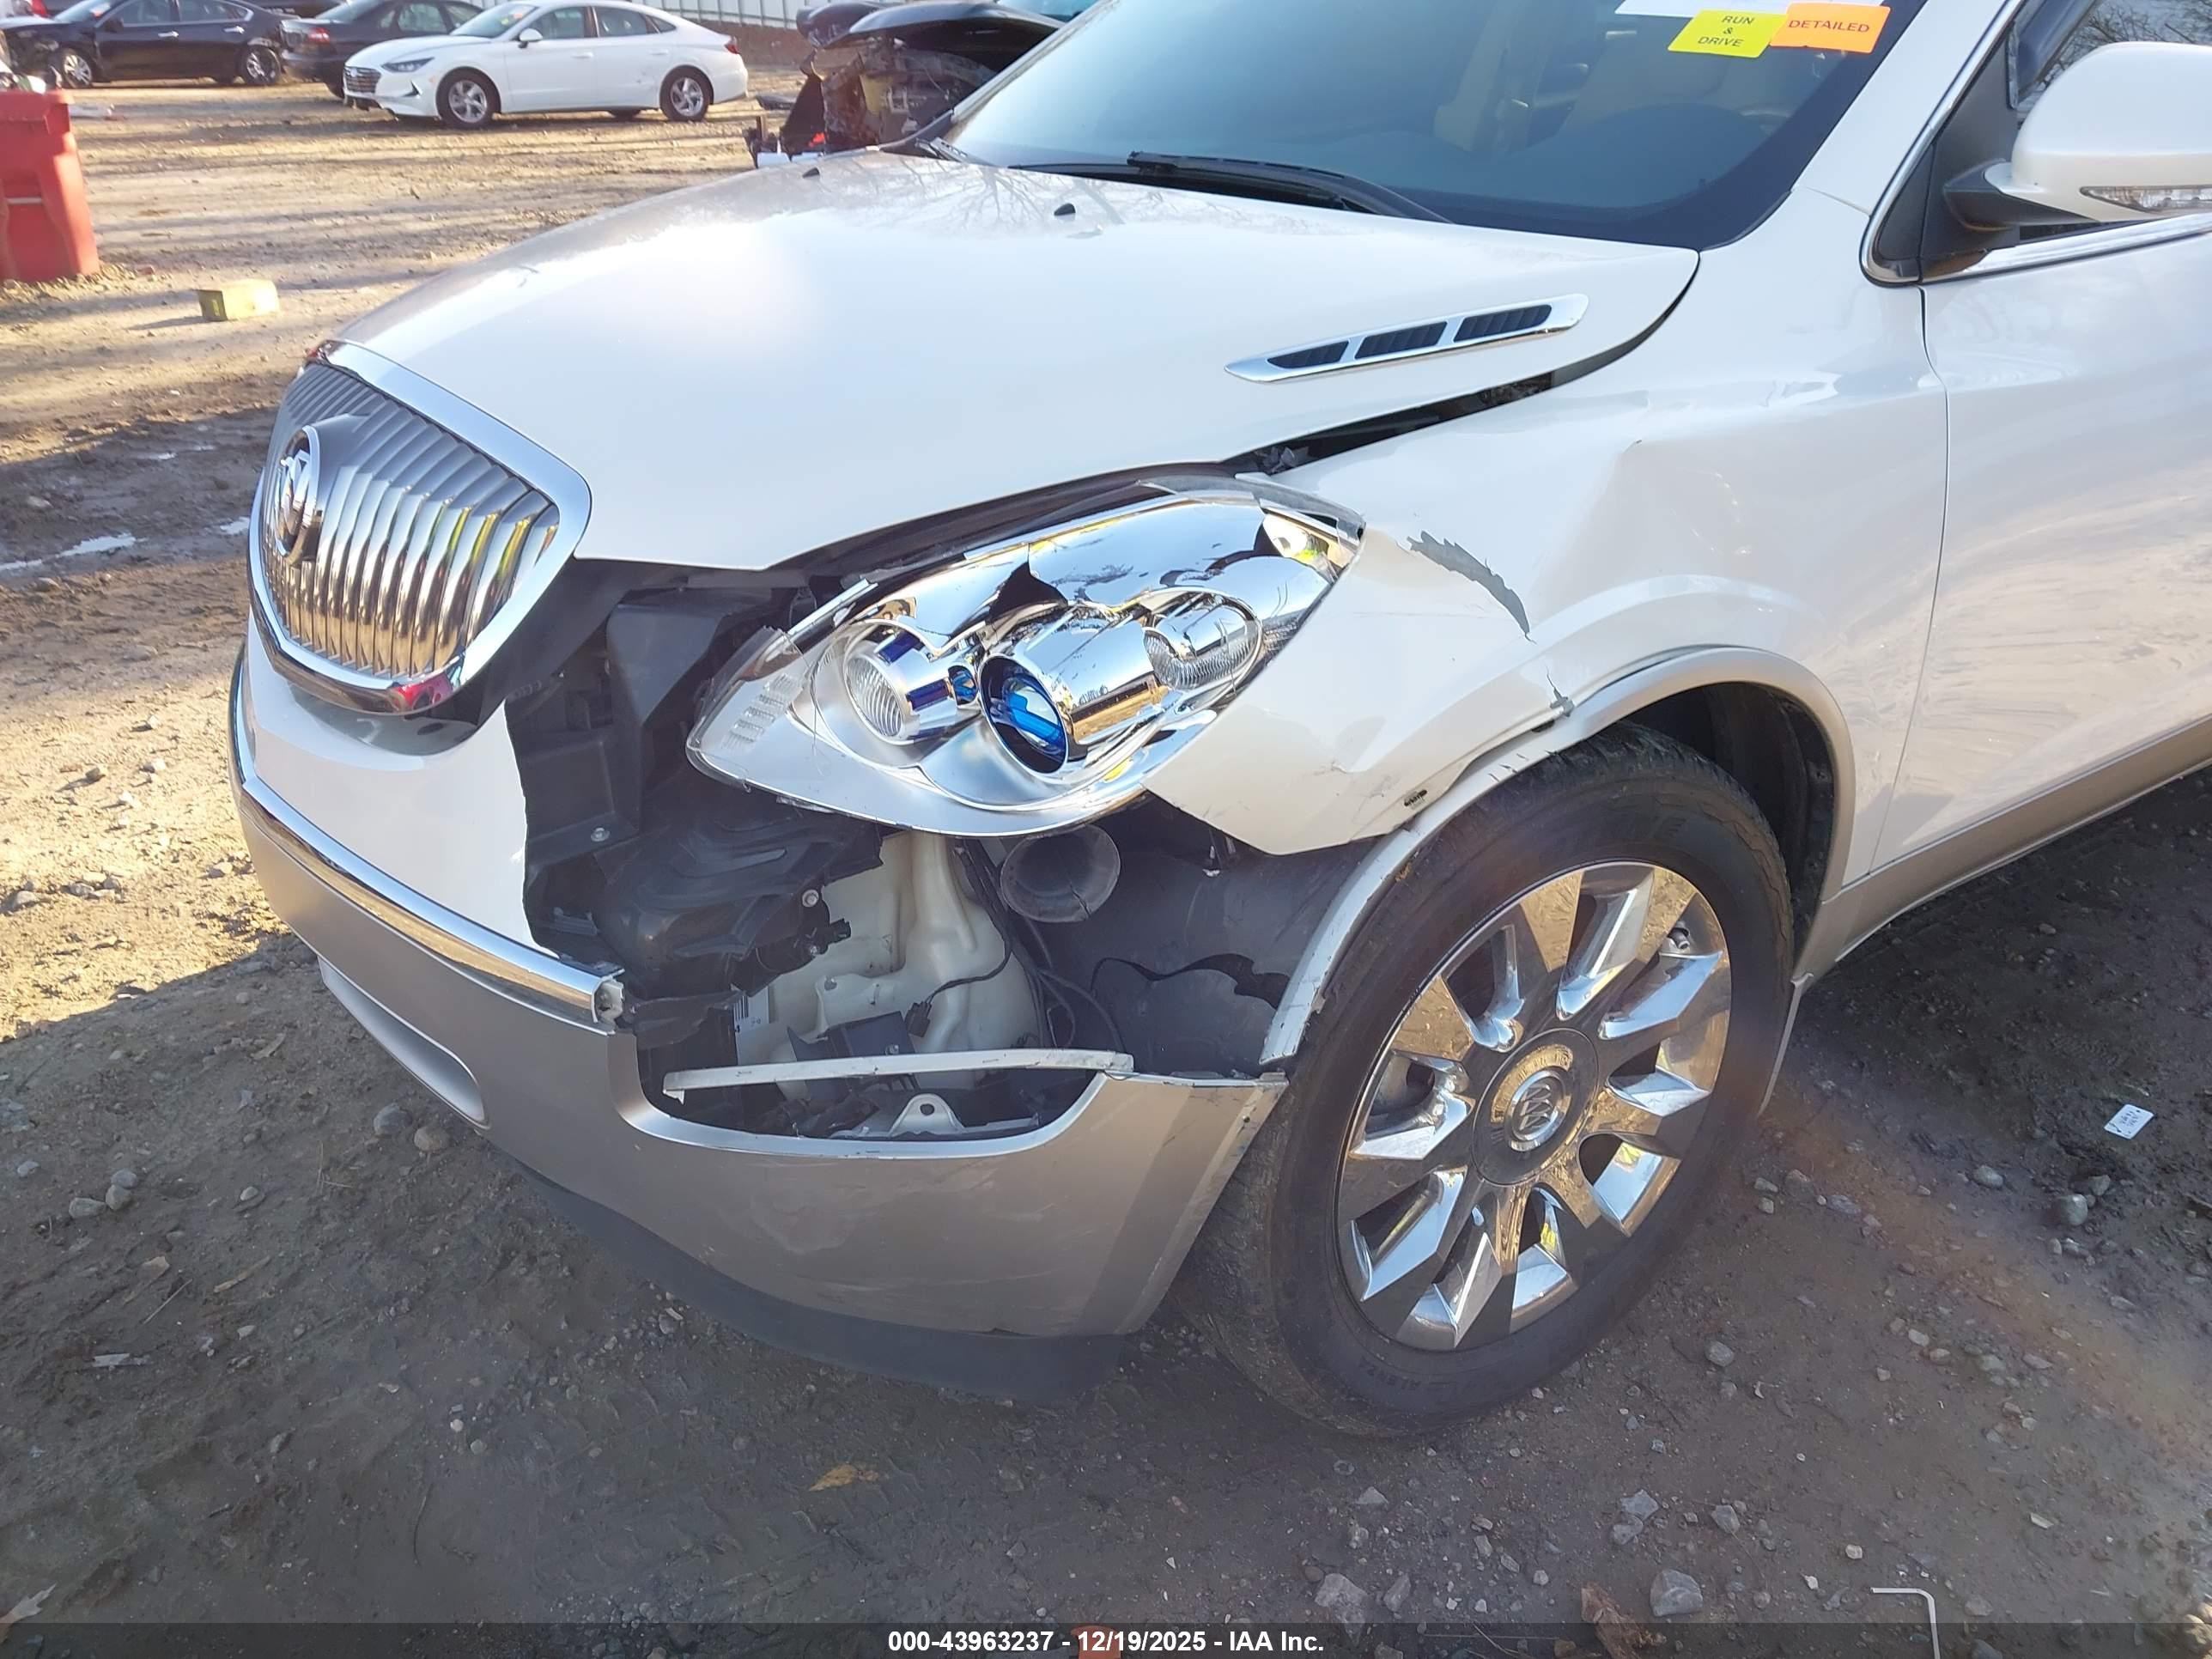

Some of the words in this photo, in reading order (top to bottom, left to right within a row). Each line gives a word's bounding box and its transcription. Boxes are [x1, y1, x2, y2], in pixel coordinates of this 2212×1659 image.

[1722, 15, 1754, 25] RUN
[1723, 27, 1734, 35] &
[1789, 20, 1869, 33] DETAILED
[1698, 36, 1744, 47] DRIVE
